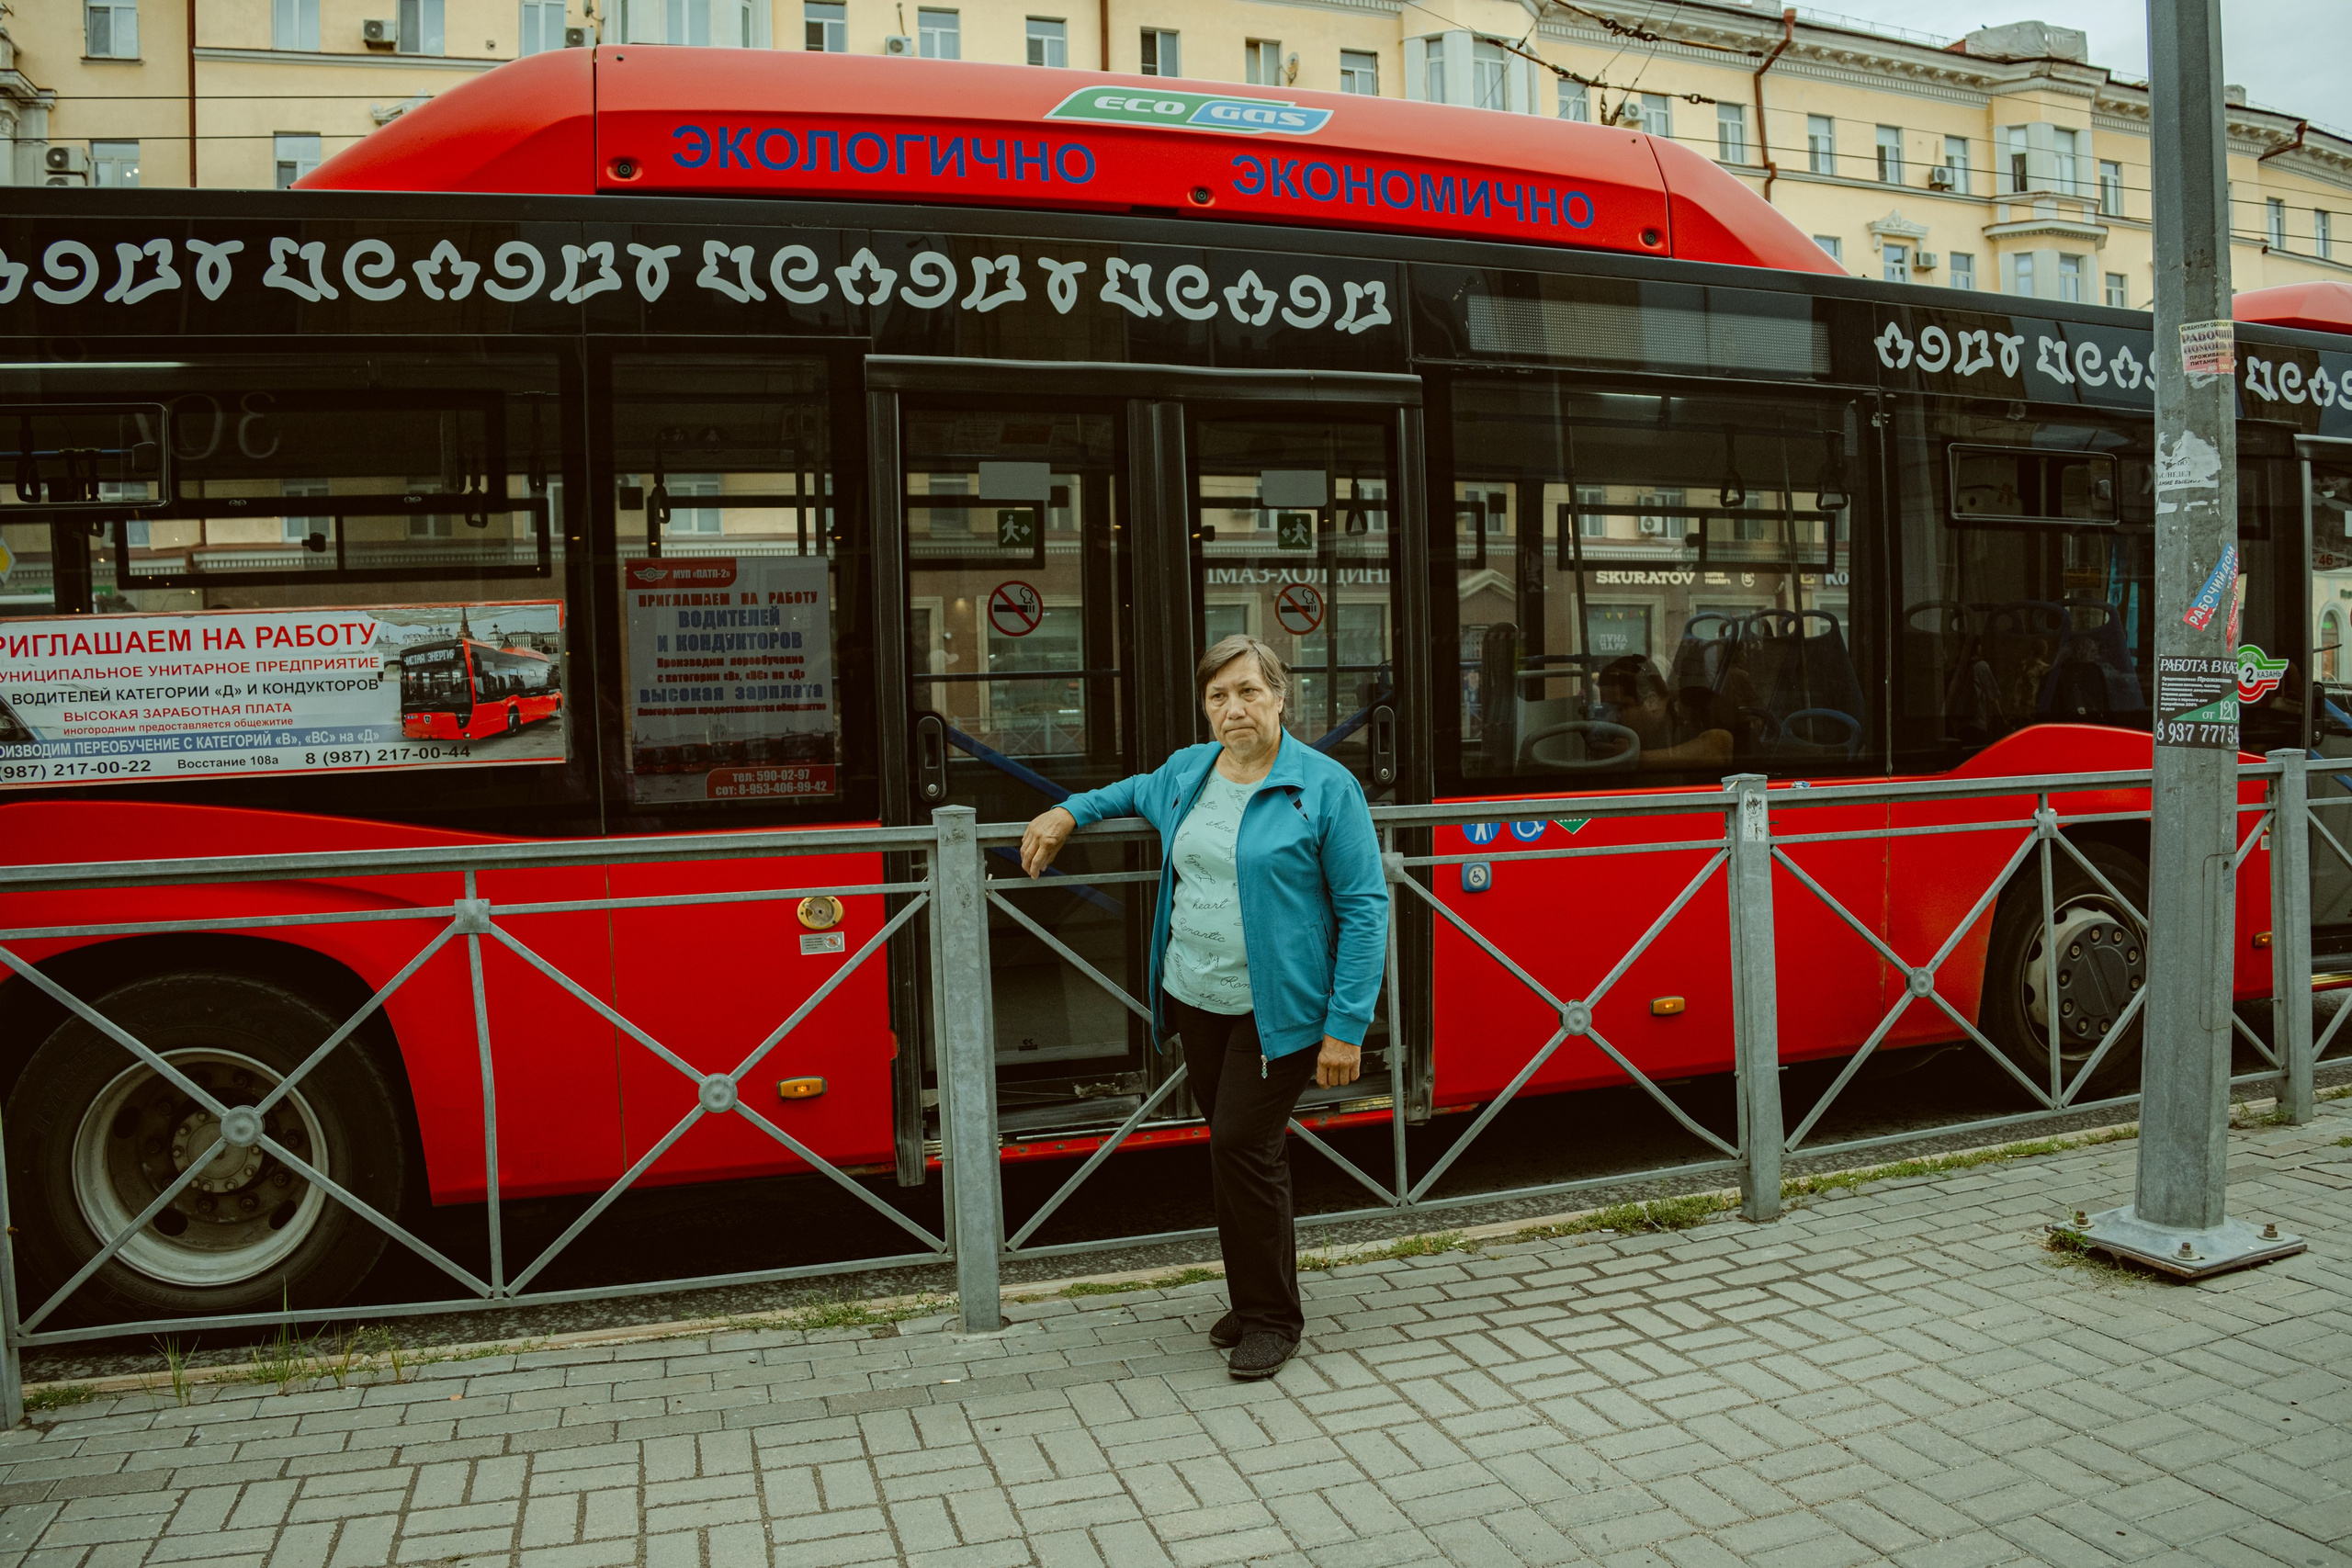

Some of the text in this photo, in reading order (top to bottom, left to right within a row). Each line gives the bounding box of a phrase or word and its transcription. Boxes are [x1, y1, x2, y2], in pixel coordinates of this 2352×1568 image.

[672, 124, 1096, 184] ЭКОЛОГИЧНО
[1231, 154, 1595, 230] ЭКОНОМИЧНО
[2190, 358, 2220, 367] ПИТАНИЕ
[673, 568, 730, 580] МУП «ПАТП-2»
[1596, 570, 1695, 585] SKURATOV
[2188, 570, 2225, 626] РАБОЧИЙ
[2222, 546, 2235, 574] ДОМ
[638, 591, 818, 607] ПРИГЛАШАЕМ НА РАБОТУ
[678, 605, 780, 629] ВОДИТЕЛЕЙ
[202, 627, 245, 651] НА
[255, 623, 376, 649] РАБОТУ
[657, 632, 803, 653] И КОНДУКТОРОВ
[148, 661, 250, 677] УНИТАРНОЕ
[256, 657, 379, 673] ПРЕДПРИЯТИЕ
[657, 657, 724, 669] Производим
[2159, 659, 2208, 672] РАБОТА
[2211, 660, 2222, 673] В
[2245, 667, 2255, 683] 2
[12, 679, 379, 706] ВОДИТЕЛЕЙ КАТЕГОРИИ «Д» И КОНДУКТОРОВ
[63, 703, 292, 722] ВЫСОКАЯ ЗАРАБОТНАЯ ПЛАТА
[63, 718, 293, 736] иногородним предоставляется общежитие
[2156, 718, 2165, 741] 8
[2168, 723, 2195, 744] 937
[74, 738, 180, 755] ПЕРЕОБУЧЕНИЕ
[184, 737, 193, 750] С
[196, 730, 271, 750] КАТЕГОРИЙ
[276, 733, 301, 747] «В»,
[305, 730, 335, 744] «ВС»
[340, 731, 354, 739] на
[357, 729, 379, 743] «Д»
[53, 760, 152, 777] 217-00-22
[177, 756, 246, 770] Восстание
[250, 755, 278, 766] 108а
[305, 752, 316, 764] 8
[322, 750, 370, 767] (987)
[378, 746, 470, 761] 217-00-44
[732, 769, 809, 783] тел: 590-02-97
[716, 781, 827, 795] сот: 8-953-406-99-42
[1193, 897, 1230, 909] heart
[1178, 918, 1225, 942] Romantic
